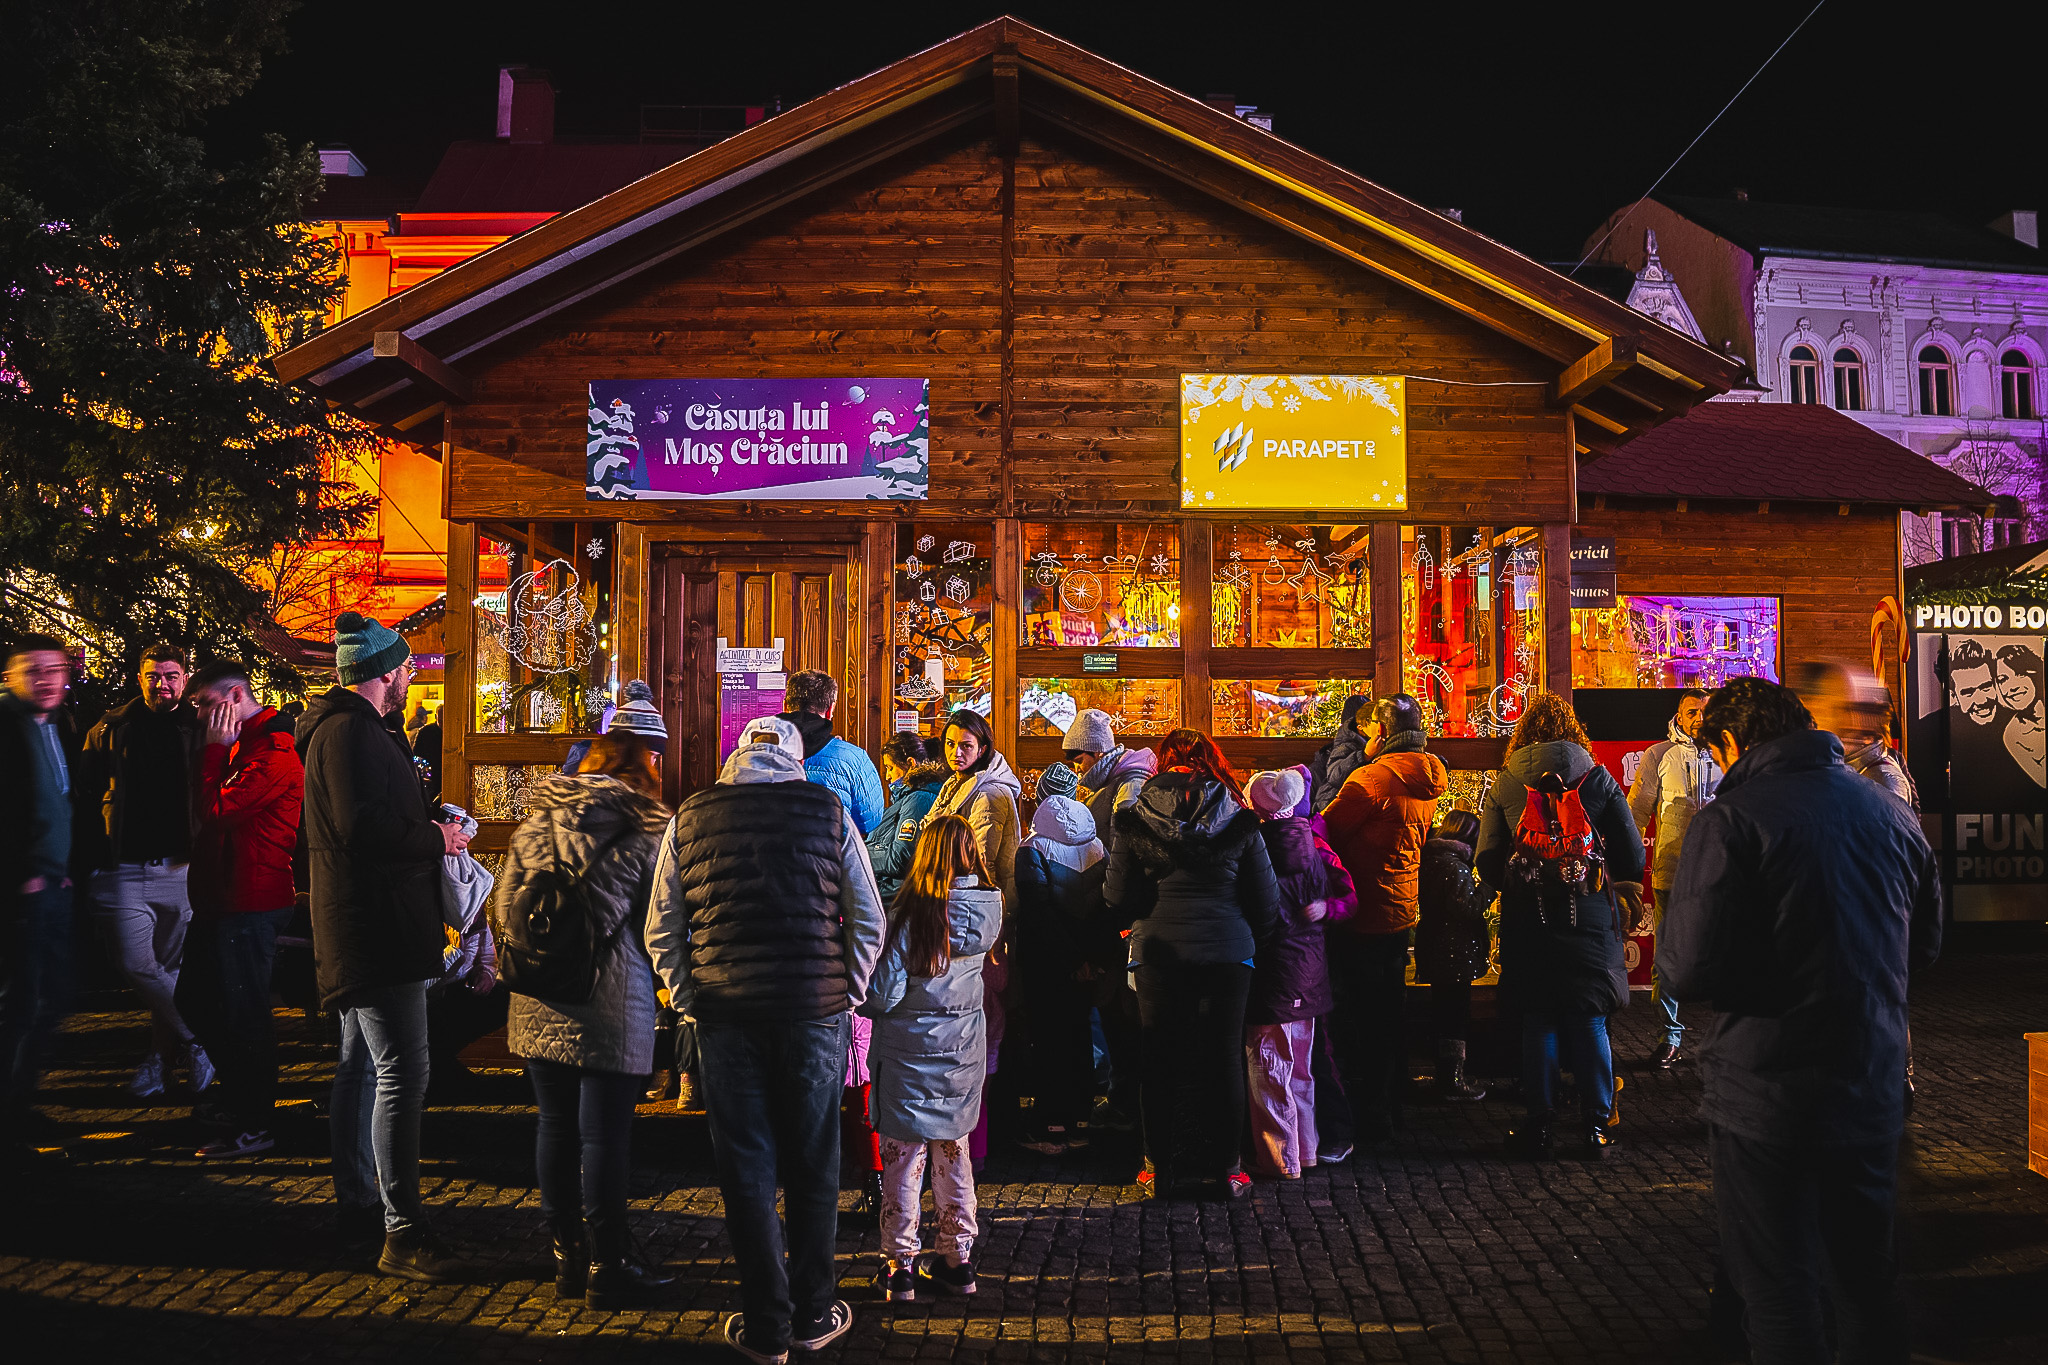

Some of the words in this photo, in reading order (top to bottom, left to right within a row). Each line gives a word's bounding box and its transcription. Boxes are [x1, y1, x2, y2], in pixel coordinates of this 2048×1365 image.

[685, 402, 785, 442] Căsuța
[792, 401, 829, 430] lui
[664, 437, 723, 477] Moș
[730, 435, 848, 465] Crăciun
[1263, 439, 1363, 459] PARAPET
[1569, 545, 1609, 560] ericit
[1570, 587, 1609, 597] stmas
[1915, 605, 2002, 629] PHOTO
[765, 651, 780, 661] CURS
[1956, 813, 2044, 851] FUN
[1956, 856, 2045, 878] PHOTO
